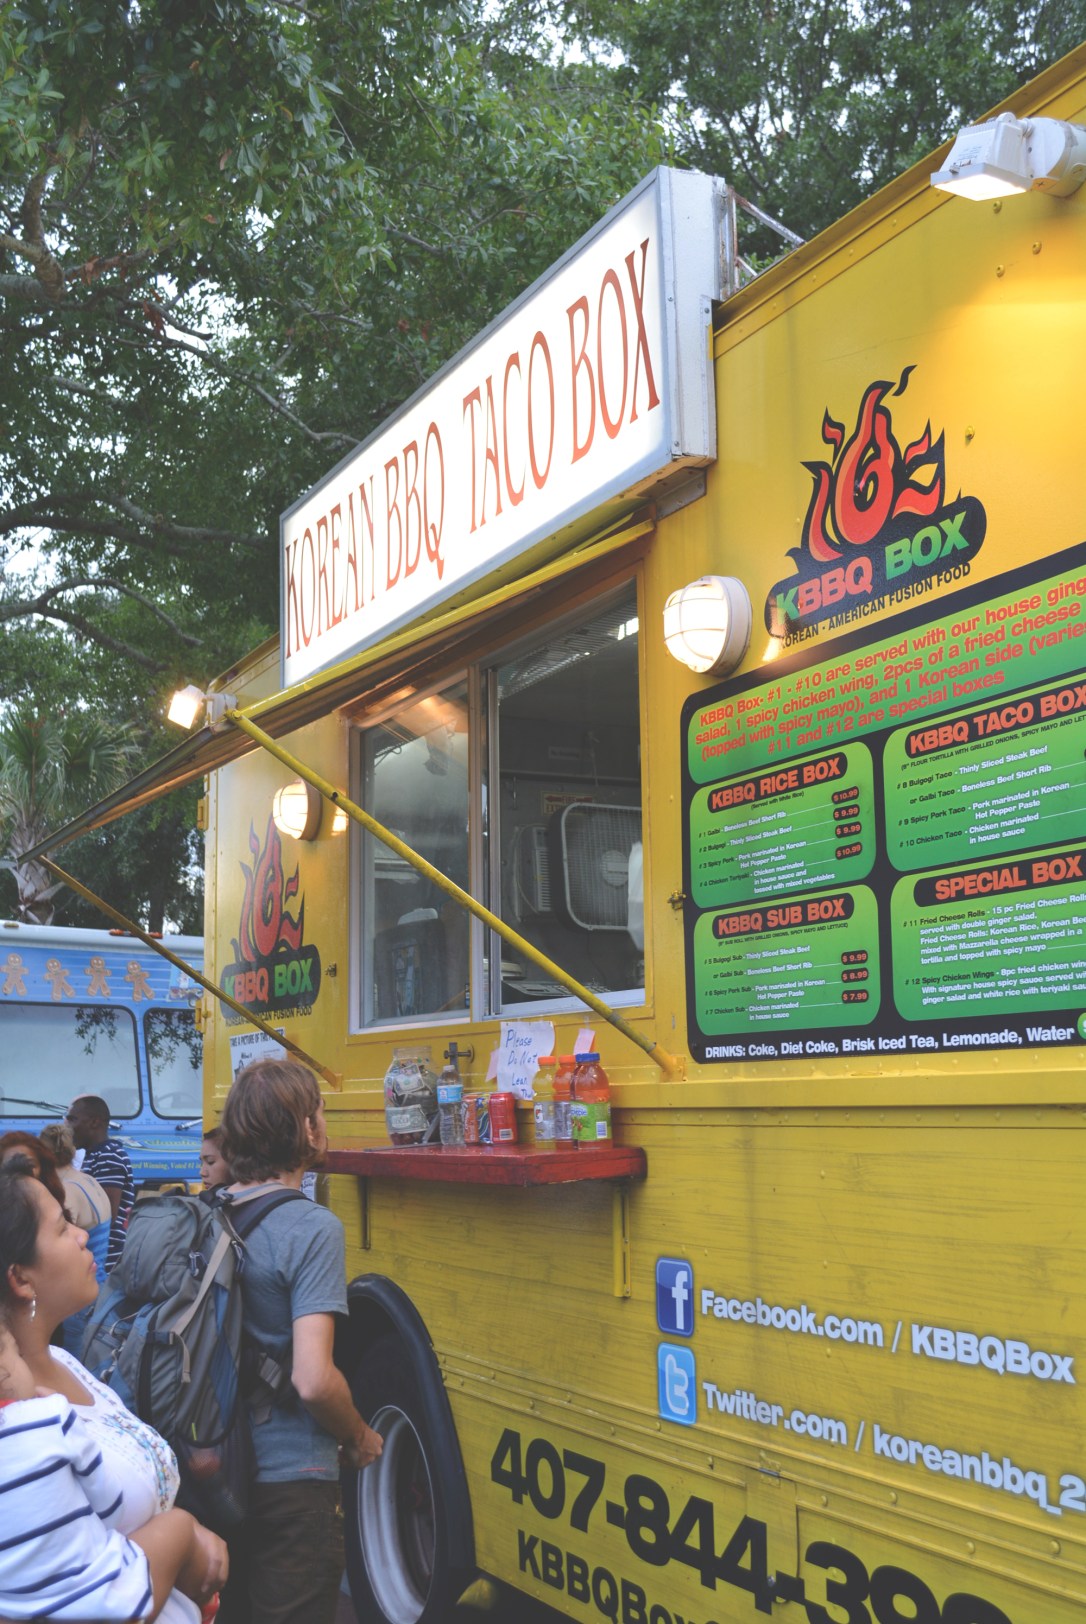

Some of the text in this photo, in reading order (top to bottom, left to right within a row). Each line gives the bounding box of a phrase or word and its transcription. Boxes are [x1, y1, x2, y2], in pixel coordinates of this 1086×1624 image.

[284, 237, 661, 659] KOREAN BBQ TACO BOX
[775, 511, 971, 622] KBBQ BOX
[828, 599, 886, 631] AMERICAN
[889, 581, 933, 606] FUSION
[937, 562, 972, 588] FOOD
[695, 722, 731, 745] salad,
[746, 706, 779, 728] spicy
[783, 686, 836, 714] chicken
[840, 671, 879, 695] wing,
[883, 656, 924, 681] 2pcs
[928, 647, 944, 666] of
[948, 644, 960, 659] a
[964, 625, 1006, 653] fried
[1011, 602, 1081, 637] cheese
[700, 704, 734, 727] KBBQ
[768, 687, 781, 702] #1
[795, 672, 822, 693] #10
[826, 664, 851, 682] are
[855, 640, 908, 672] served
[912, 627, 946, 655] with
[951, 616, 981, 637] our
[985, 595, 1042, 626] house
[701, 734, 746, 762] (topped
[749, 724, 775, 744] with
[778, 714, 813, 736] spicy
[817, 696, 865, 724] mayo),
[869, 682, 898, 705] and
[904, 679, 911, 693] 1
[919, 657, 980, 688] Korean
[985, 643, 1024, 666] side
[768, 670, 1006, 754] #11 and #12 are special boxes
[910, 684, 1086, 755] KBBQ TACO BOX
[712, 783, 756, 810] KBBQ
[760, 769, 799, 796] RICE
[803, 757, 841, 784] BOX
[959, 764, 980, 776] Thinly
[981, 757, 1004, 769] Sliced
[1006, 751, 1028, 763] Steak
[1029, 745, 1048, 757] Beef
[972, 800, 990, 811] Pork
[992, 791, 1030, 806] marinated
[1040, 782, 1070, 795] Korean
[935, 855, 1083, 900] SPECIAL BOX
[718, 912, 763, 936] KBBQ
[767, 903, 802, 927] SUB
[807, 898, 846, 921] BOX
[1015, 901, 1035, 911] Fried
[1037, 897, 1067, 907] Cheese
[1030, 929, 1065, 941] wrapped
[224, 958, 313, 1004] KBBQ BOX
[1038, 961, 1069, 972] chicken
[296, 1005, 313, 1017] FOOD
[505, 1029, 532, 1048] Please
[705, 1025, 1075, 1058] DRINKS: Coke, Diet Coke, Brisk Iced Tea, Lemonade, Water
[701, 1289, 884, 1347] Facebook.com
[911, 1323, 1076, 1384] KBBQBox
[702, 1382, 848, 1445] Twitter.com
